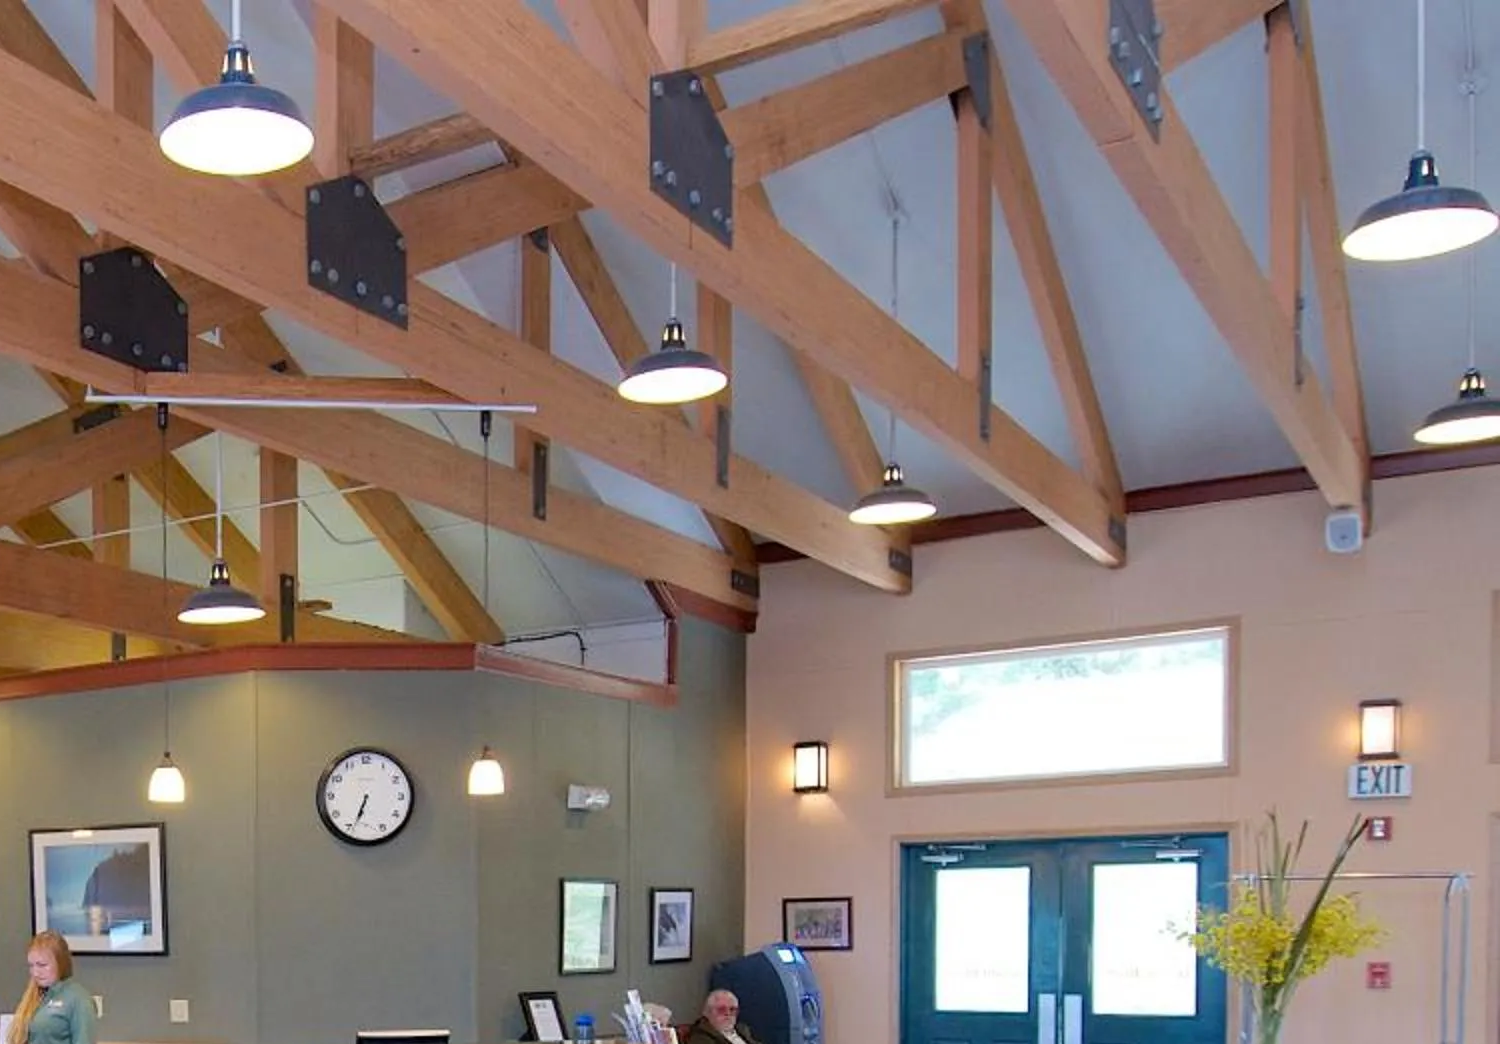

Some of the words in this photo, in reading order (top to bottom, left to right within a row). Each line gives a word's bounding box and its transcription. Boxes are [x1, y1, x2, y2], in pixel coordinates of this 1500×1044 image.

[361, 755, 372, 765] 12
[345, 762, 354, 770] 11
[332, 774, 342, 783] 10
[1356, 765, 1405, 795] EXIT
